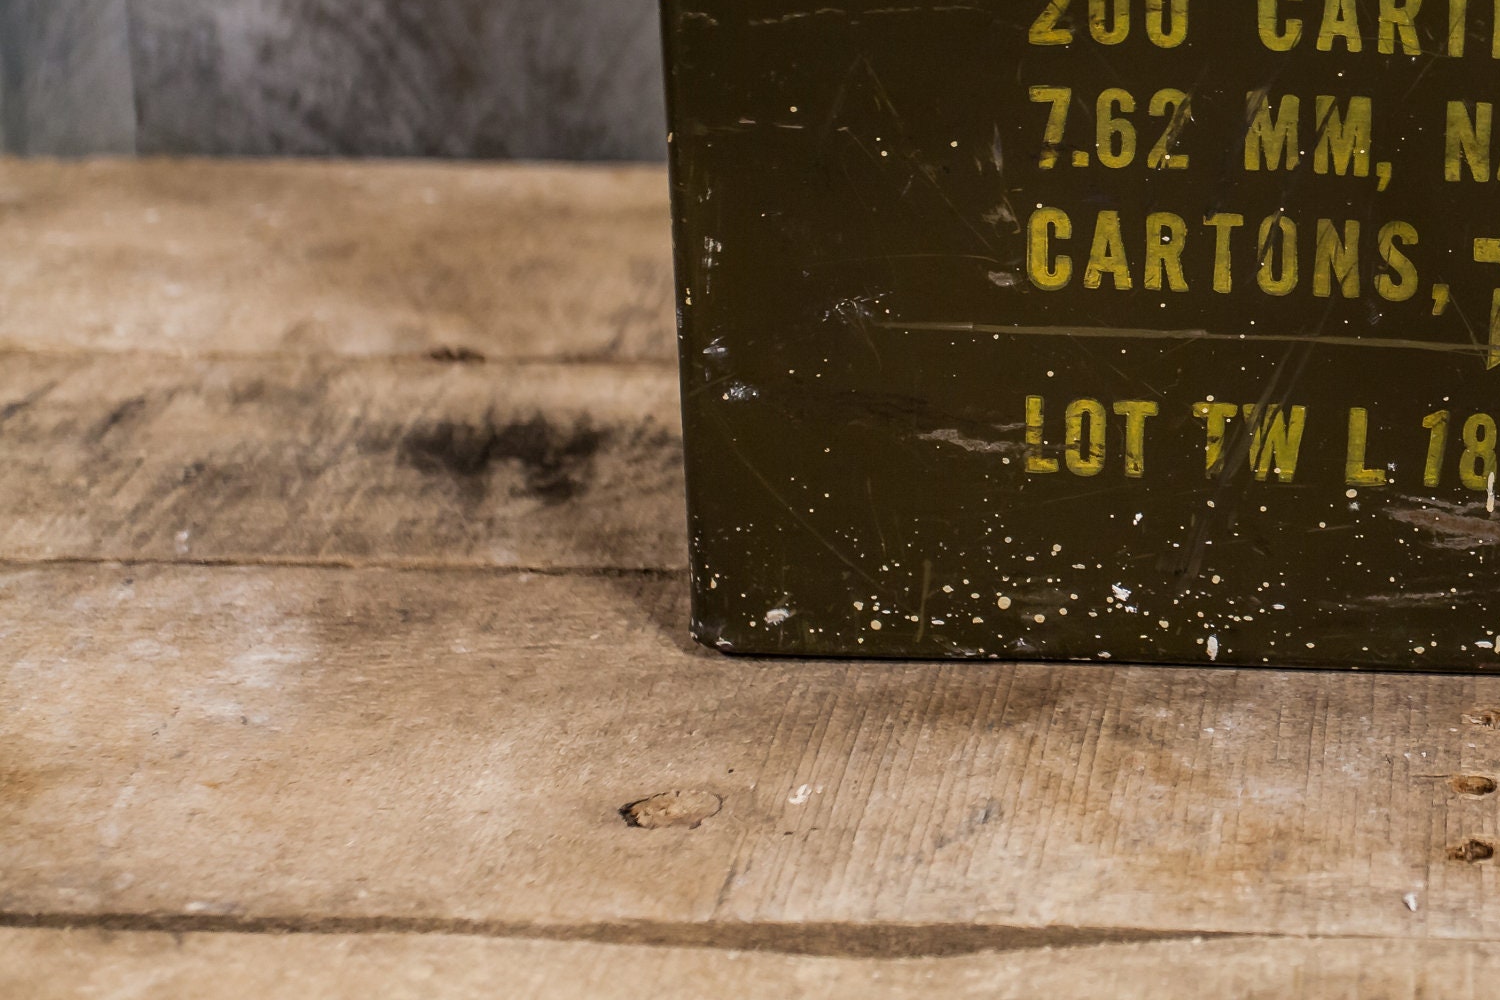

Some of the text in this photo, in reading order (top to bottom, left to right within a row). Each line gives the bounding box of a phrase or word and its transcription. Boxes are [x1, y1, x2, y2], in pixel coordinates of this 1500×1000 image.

[1027, 85, 1191, 170] 7.62
[1244, 91, 1392, 192] MM,
[1025, 206, 1451, 317] CARTONS,
[1023, 394, 1159, 478] LOT
[1192, 401, 1306, 484] TW
[1345, 408, 1386, 487] L
